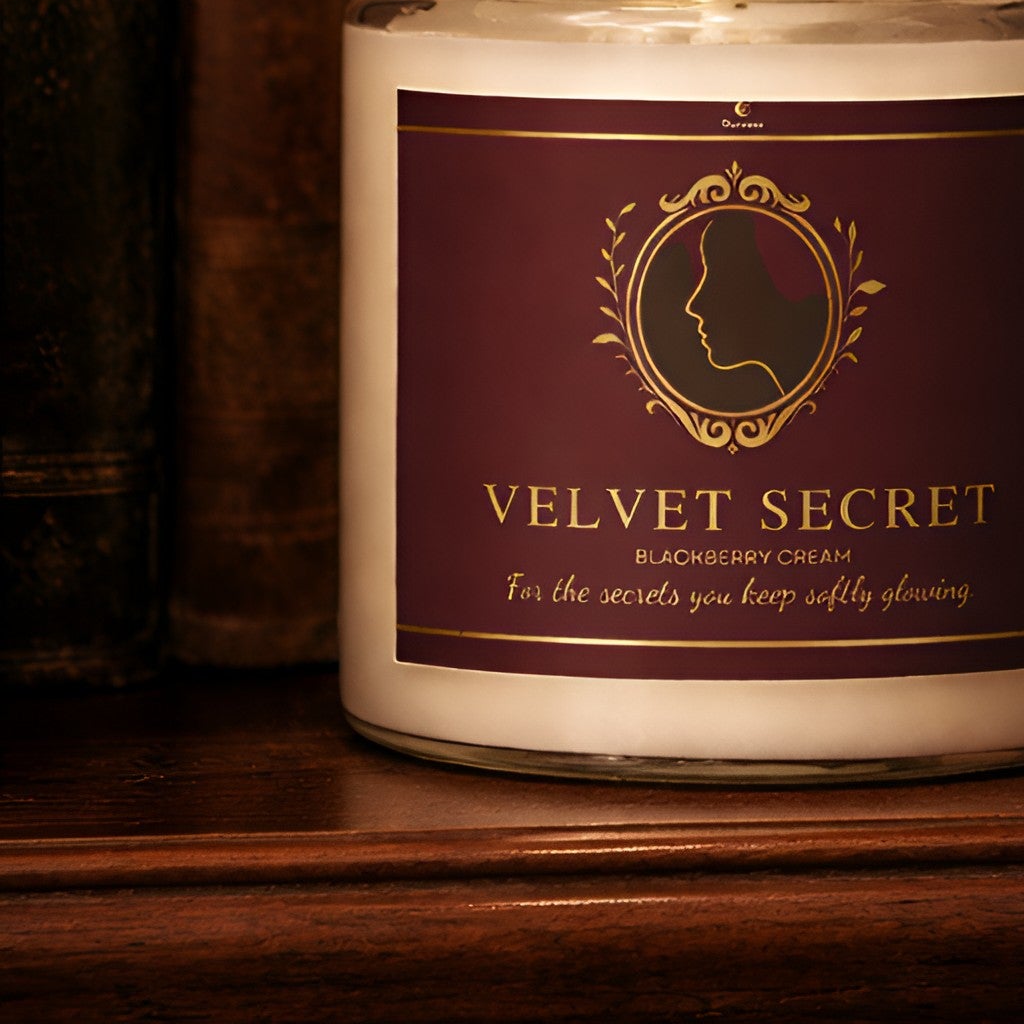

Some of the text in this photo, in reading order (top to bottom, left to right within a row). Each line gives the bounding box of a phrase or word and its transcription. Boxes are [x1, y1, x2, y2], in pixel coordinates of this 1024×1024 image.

[483, 483, 996, 531] VELVET SECRET
[636, 549, 851, 565] BLACKBERRY CREAM
[507, 572, 541, 601] For
[552, 574, 591, 603] the
[599, 580, 680, 606] secrets
[690, 590, 733, 613] you
[741, 577, 796, 613] keep
[805, 574, 873, 612] softly
